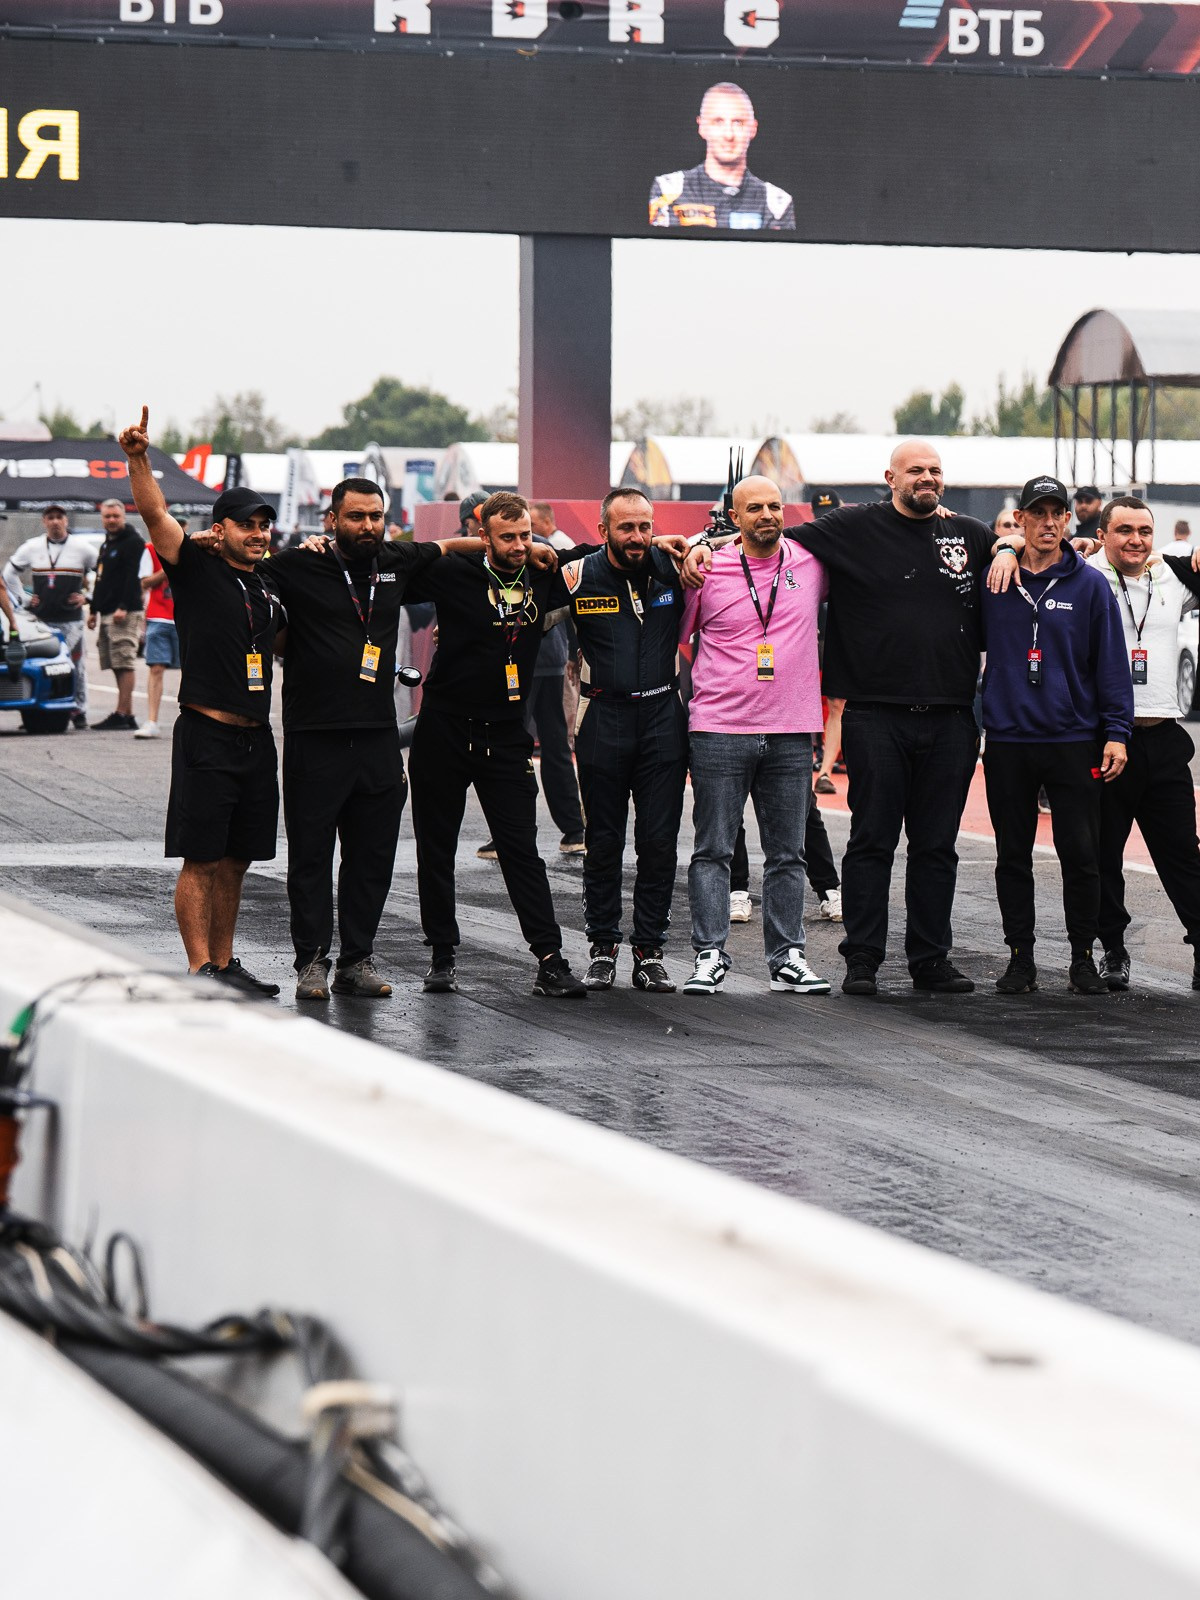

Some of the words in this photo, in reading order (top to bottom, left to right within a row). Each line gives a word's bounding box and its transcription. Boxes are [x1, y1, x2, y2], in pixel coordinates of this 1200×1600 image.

[948, 8, 1045, 57] ВТБ
[0, 107, 80, 181] я
[577, 598, 618, 610] RDRC
